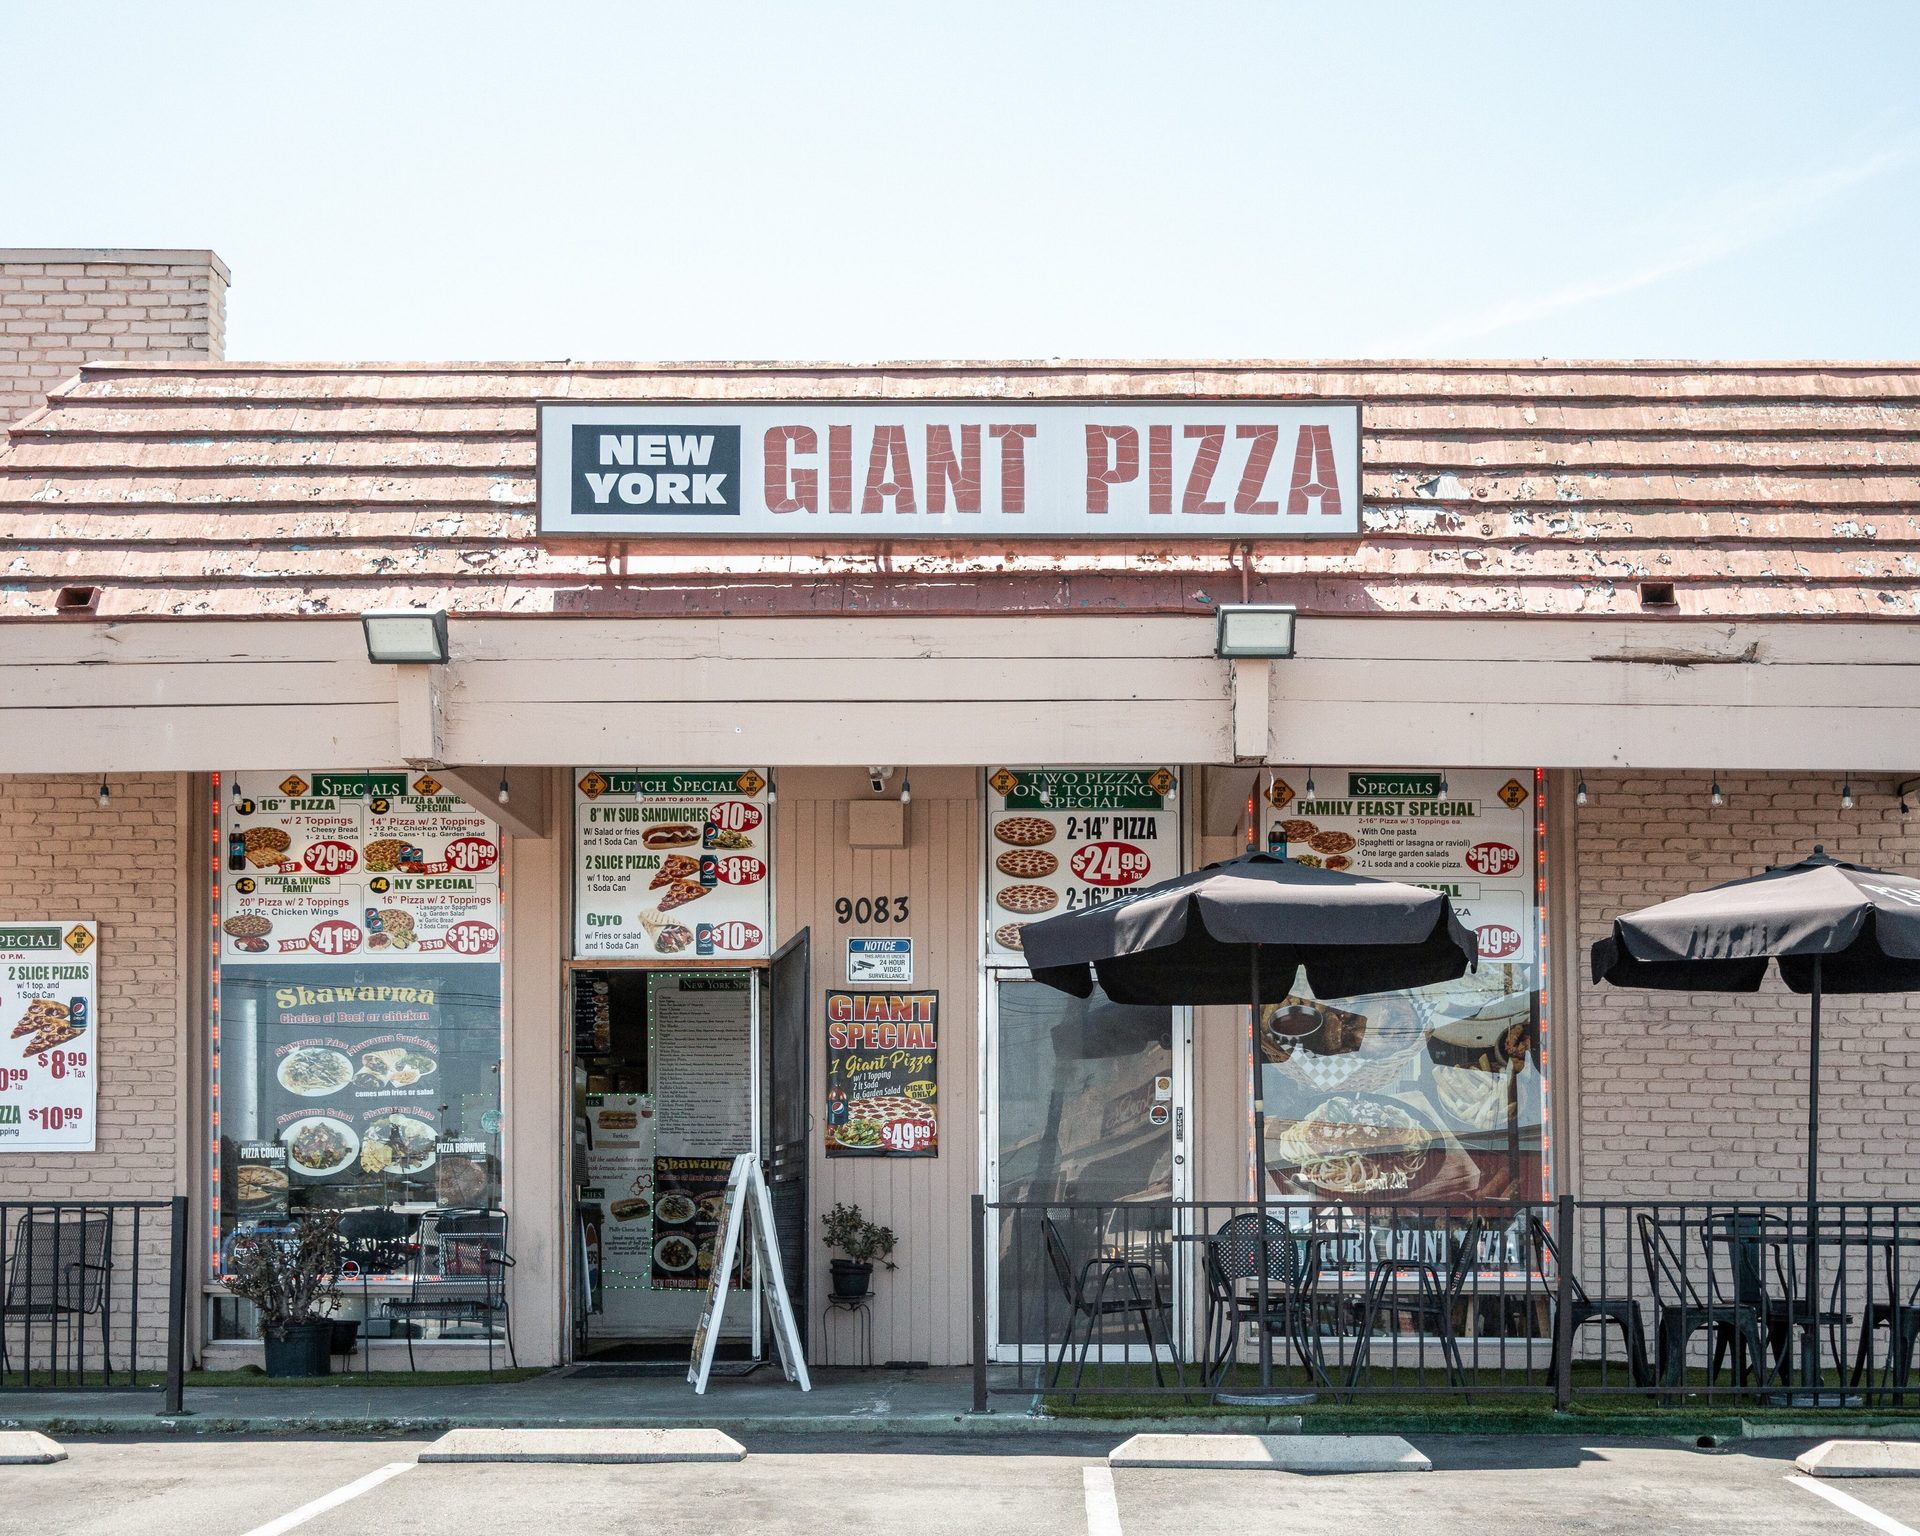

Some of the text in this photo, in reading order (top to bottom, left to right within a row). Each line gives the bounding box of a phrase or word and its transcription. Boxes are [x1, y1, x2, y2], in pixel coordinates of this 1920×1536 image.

[599, 434, 715, 466] NEW
[763, 424, 1343, 516] GIANT PIZZA
[584, 473, 728, 505] YORK
[674, 776, 736, 792] SPECIAL
[1028, 773, 1142, 784] TWO PIZZA
[321, 779, 400, 795] SPECALS
[1058, 785, 1153, 796] TOPPING
[1357, 778, 1433, 795] SPECIALS
[291, 800, 335, 810] PIZZA
[1297, 801, 1475, 816] FAMILY FEAST SPECIAL
[604, 808, 708, 822] NY SUB SANDWICHES
[305, 817, 353, 826] Toppings
[440, 818, 485, 827] Toppings
[1114, 817, 1157, 839] PIZZA
[1397, 828, 1417, 837] pasta
[1406, 839, 1434, 848] lasagna
[1378, 850, 1397, 859] large
[1399, 850, 1424, 858] garden
[586, 855, 660, 869] 2 SLICE PIZZAS
[1442, 861, 1462, 869] pizza.
[602, 875, 616, 883] top.
[1131, 871, 1143, 879] Tax
[283, 885, 313, 893] FAMILY
[395, 879, 474, 889] NY SPECIAL
[259, 898, 349, 907] Pizza 2 Toppings
[401, 896, 491, 905] Pizza Toppings
[311, 909, 339, 917] Wings
[835, 896, 909, 924] 9083
[587, 913, 623, 927] Gyro
[864, 941, 896, 951] NOTICE
[9, 966, 89, 980] 2 SLICE PIZZAS
[275, 985, 434, 1008] Shawarma
[829, 995, 936, 1022] GIANT
[280, 1011, 429, 1023] Choice Beef chicken
[829, 1023, 937, 1049] SPECIAL
[846, 1050, 934, 1078] Giant Pizza
[868, 1071, 891, 1083] Topping
[864, 1081, 879, 1089] Soda
[862, 1086, 900, 1097] Garden Salad
[241, 1147, 286, 1158] PIZZA COOKIE
[437, 1142, 486, 1153] PIZZA BROWNIE
